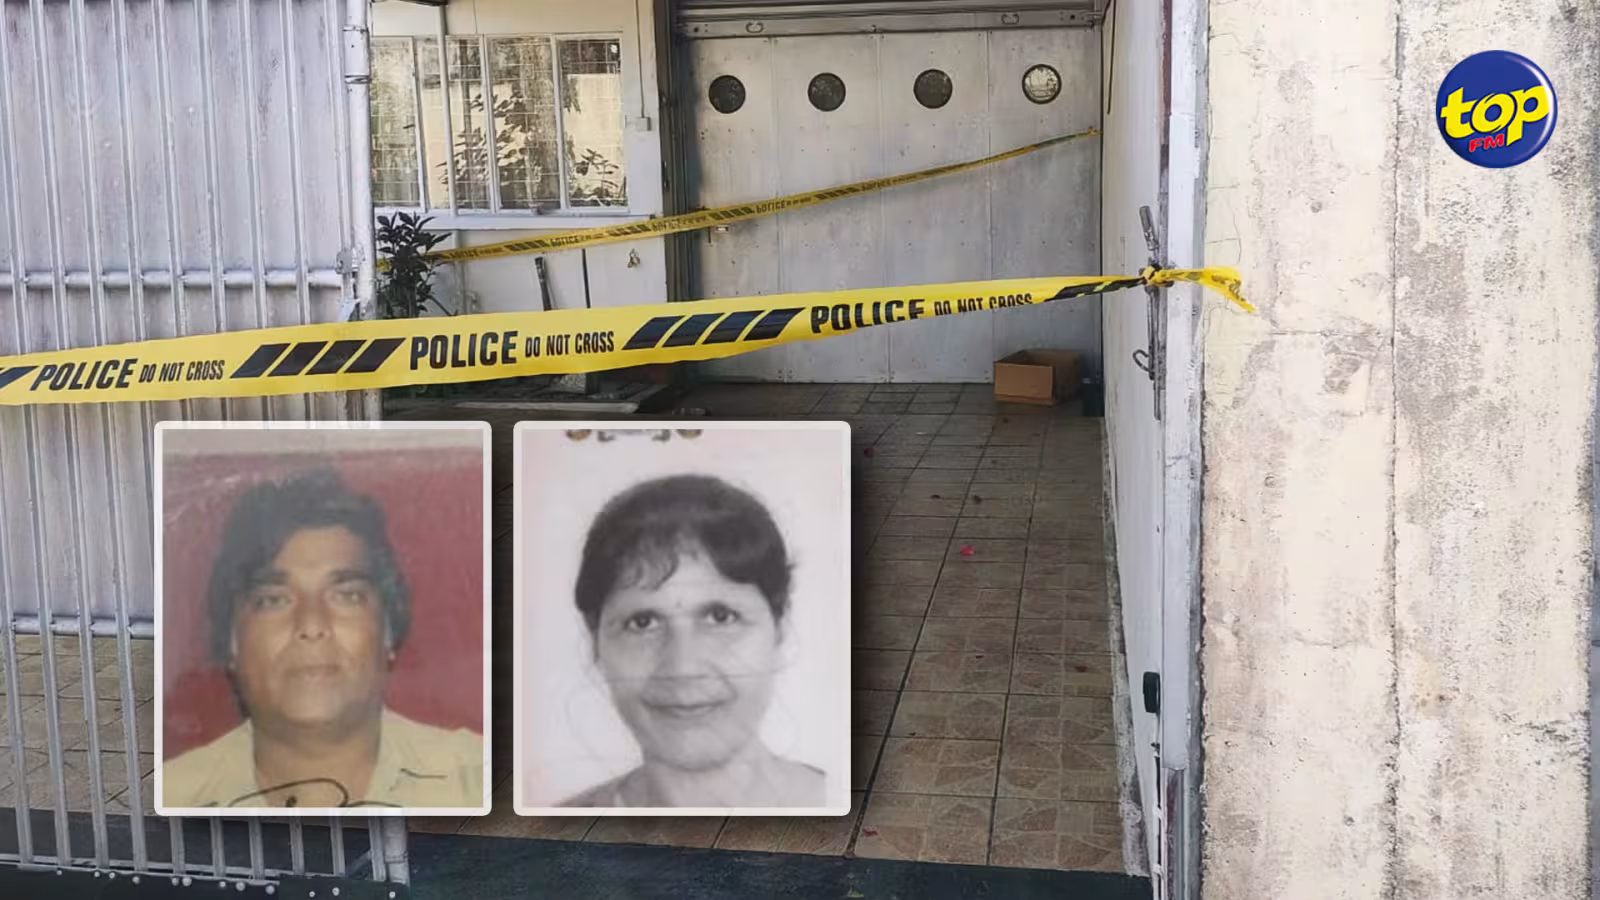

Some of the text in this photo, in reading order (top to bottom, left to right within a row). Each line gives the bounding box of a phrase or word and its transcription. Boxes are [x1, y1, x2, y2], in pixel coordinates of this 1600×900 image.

[810, 299, 925, 334] POLICE
[934, 301, 951, 316] DO
[958, 297, 983, 313] NOT
[410, 330, 615, 371] POLICE DO NOT CROSS
[30, 358, 225, 391] POLICE DO NOT CROSS
